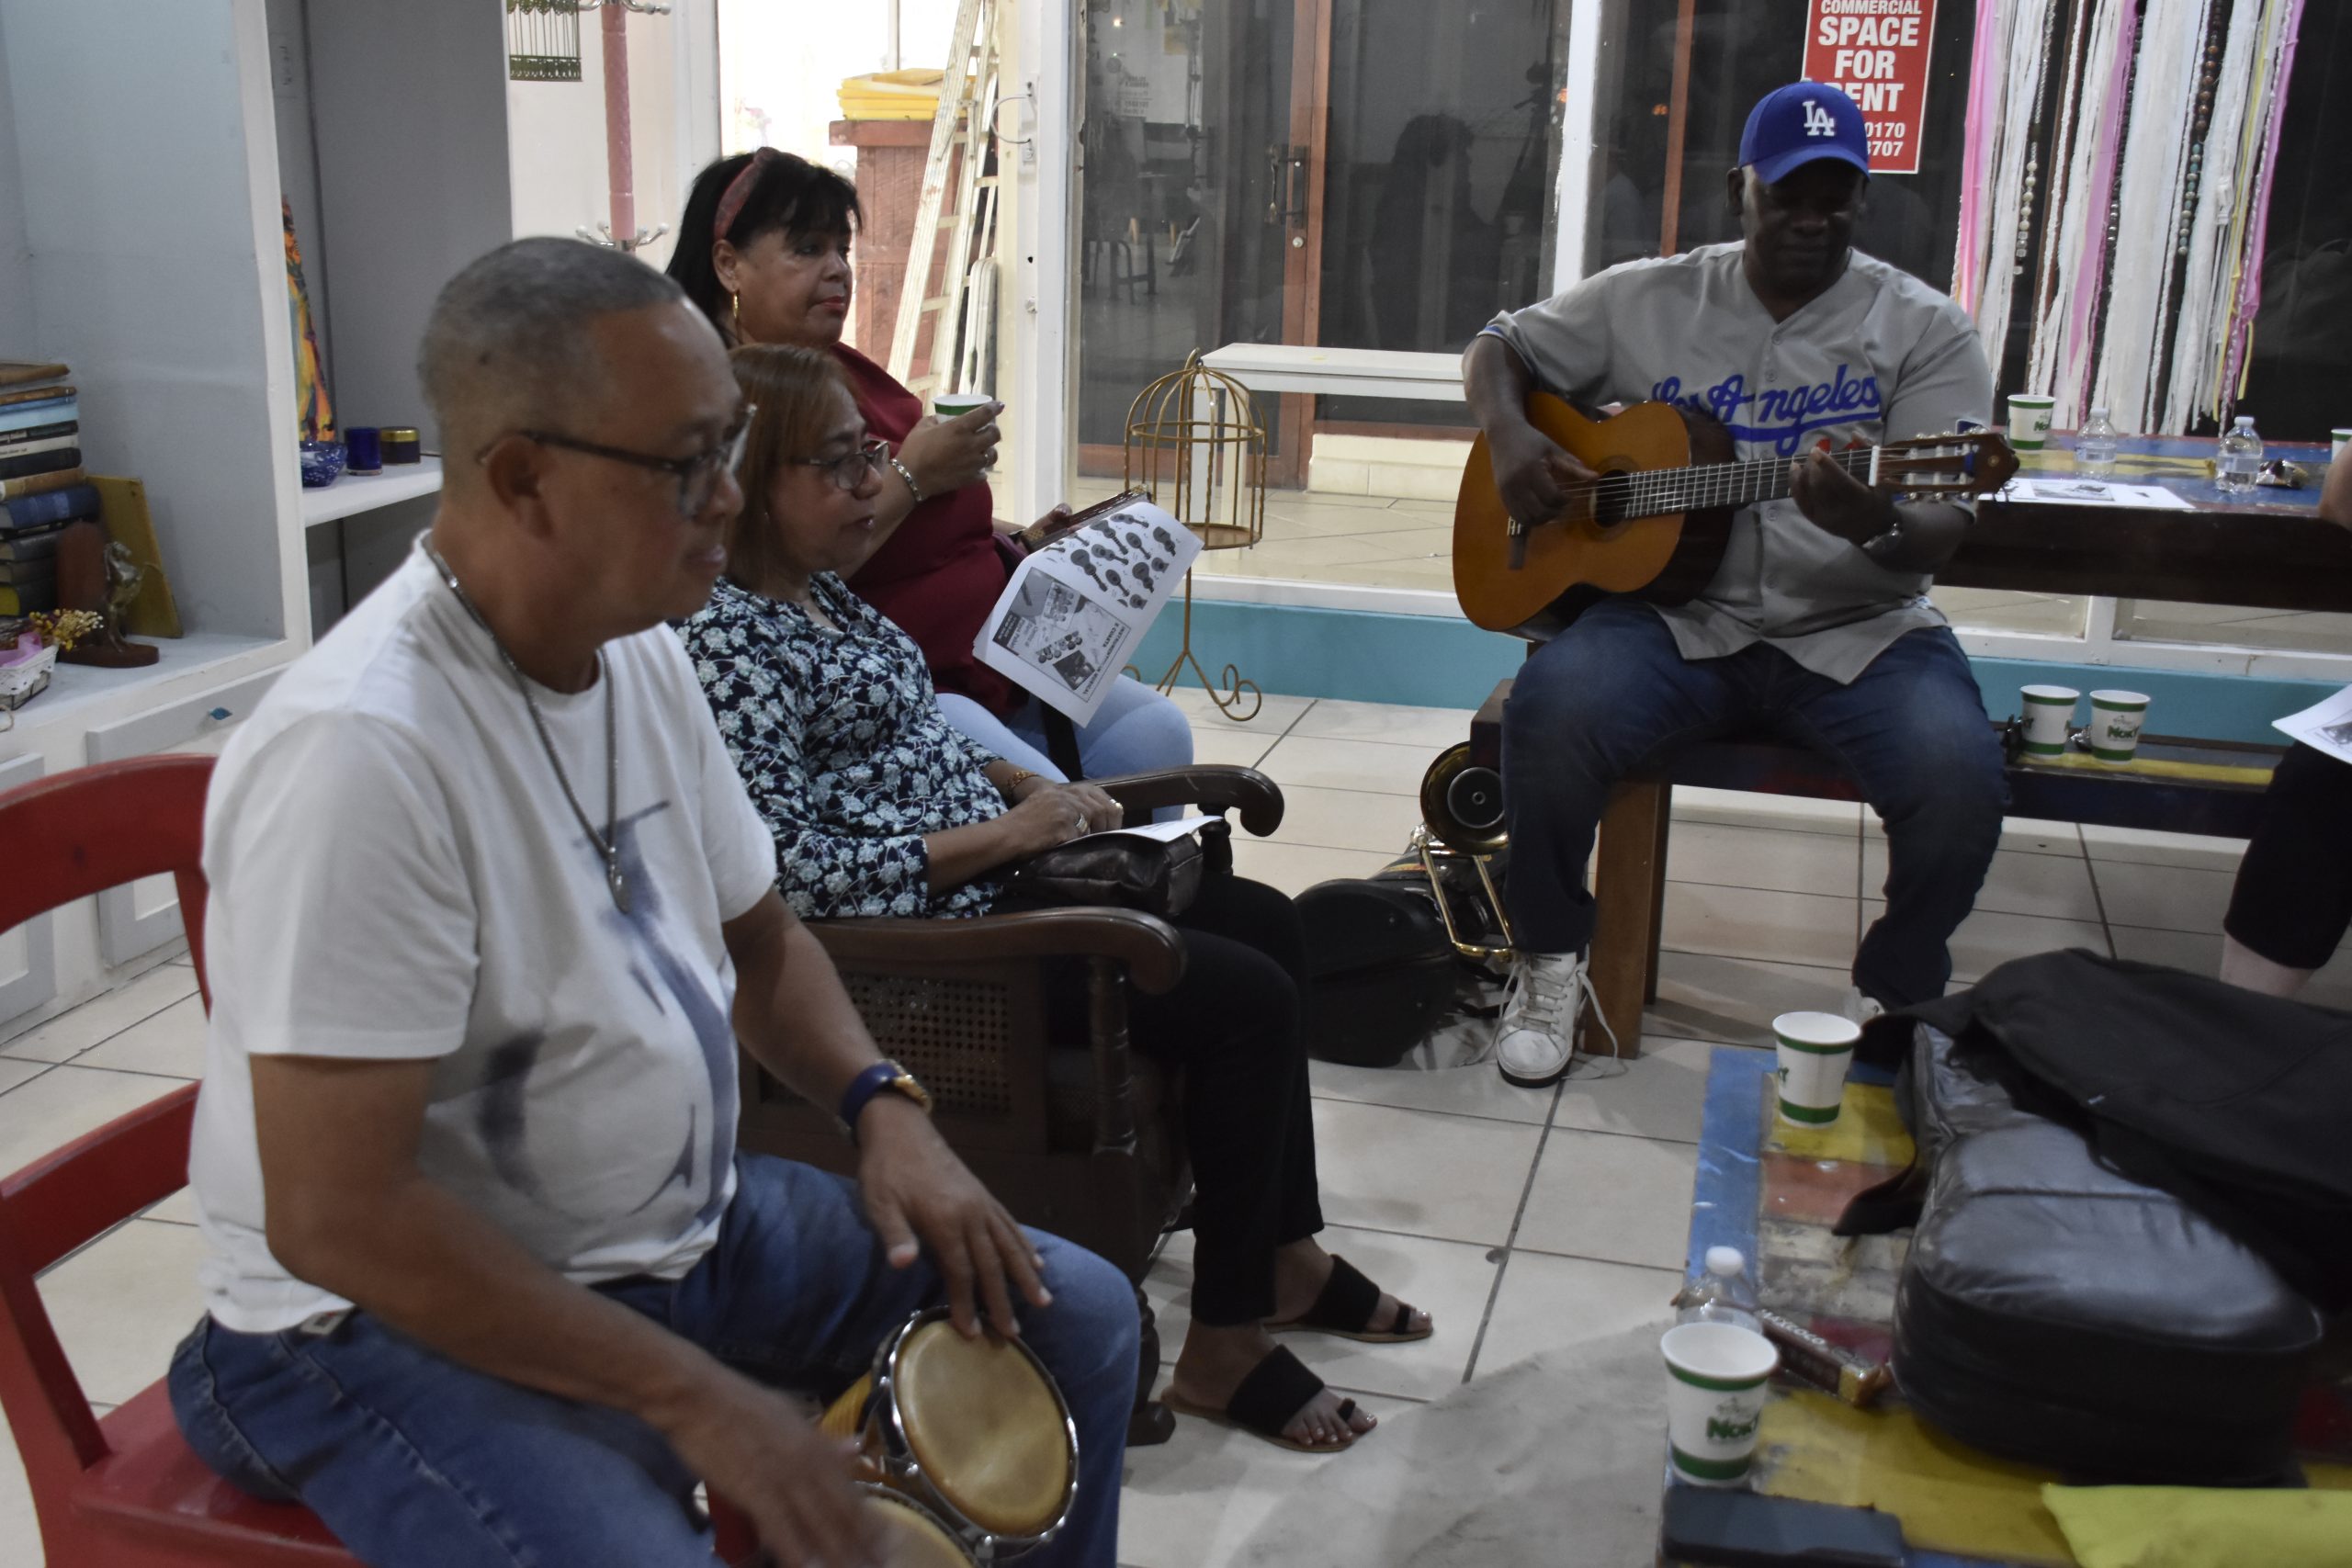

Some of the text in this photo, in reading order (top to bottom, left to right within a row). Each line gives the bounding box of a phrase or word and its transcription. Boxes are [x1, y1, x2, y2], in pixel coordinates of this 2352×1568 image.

[1820, 0, 1923, 15] COMMERCIAL
[1817, 17, 1921, 47] SPACE
[1834, 50, 1896, 80] FOR
[1824, 82, 1905, 112] ENT
[1802, 100, 1836, 137] LA
[1707, 364, 1881, 457] Angeles
